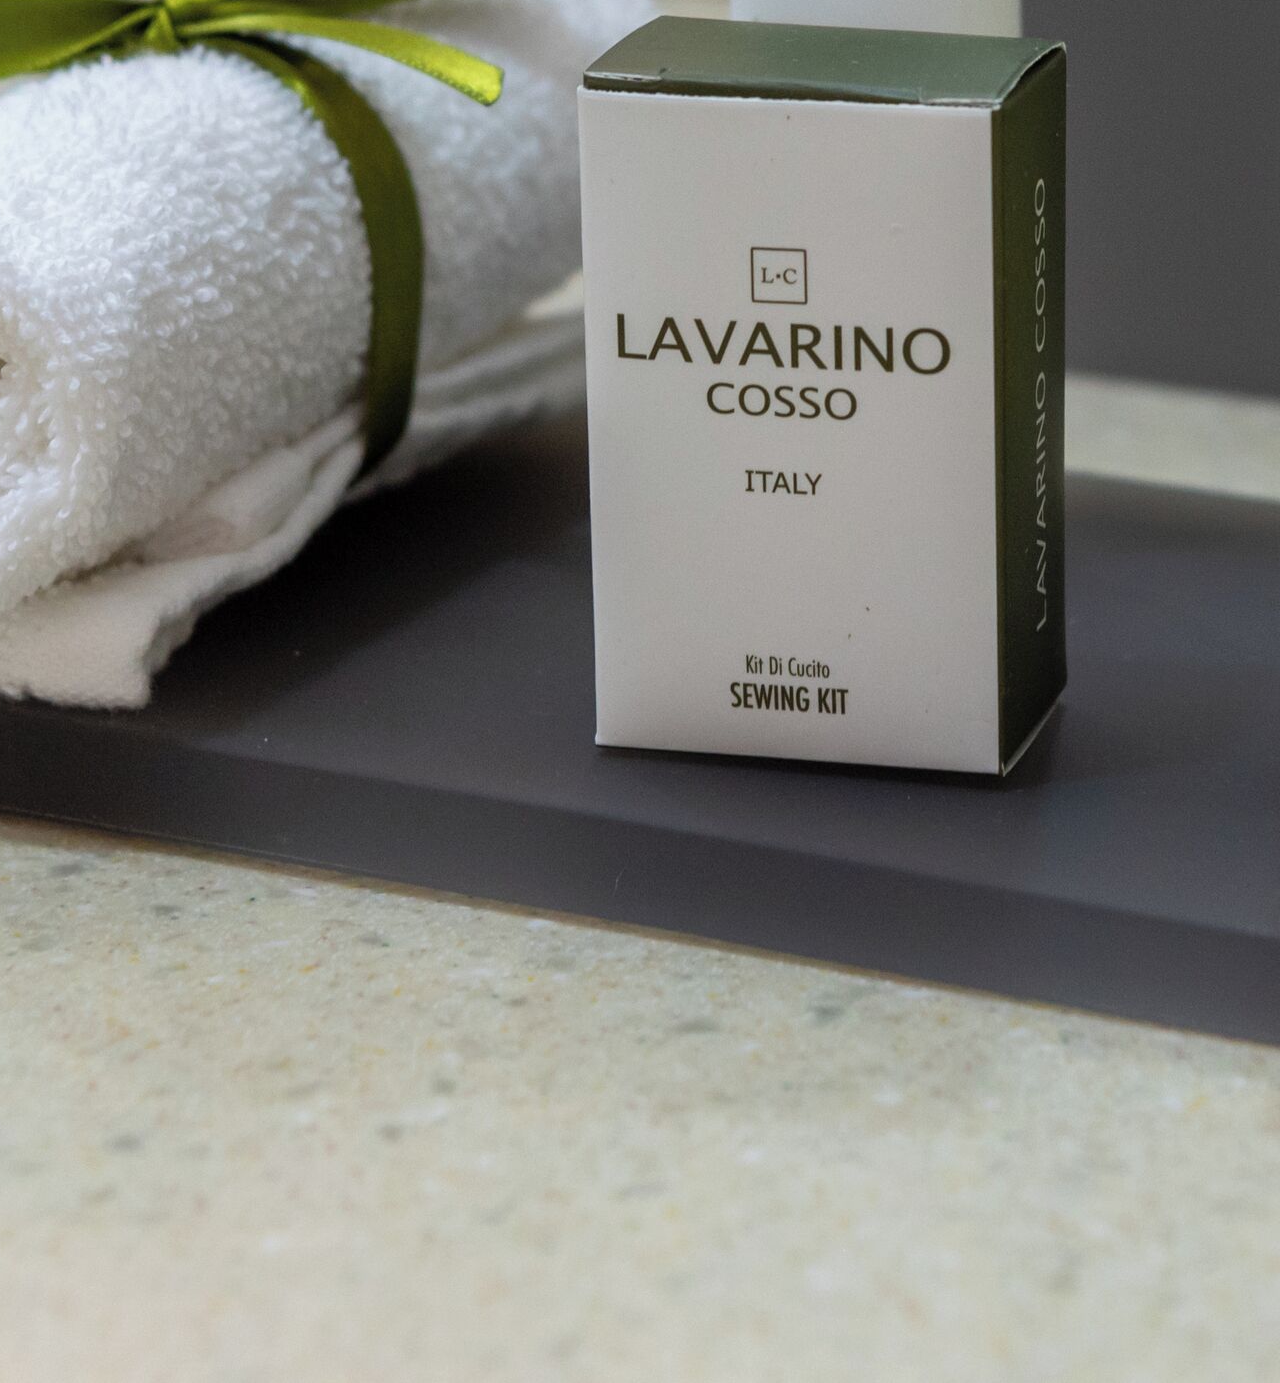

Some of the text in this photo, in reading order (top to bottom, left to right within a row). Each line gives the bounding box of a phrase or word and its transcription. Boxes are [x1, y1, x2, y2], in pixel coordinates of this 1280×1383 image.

[616, 312, 952, 376] LAVARINO
[706, 381, 858, 421] COSSO
[1033, 177, 1048, 631] LAVARINO COSSO
[744, 469, 823, 496] ITALY
[745, 654, 831, 679] Kit Di Cucito
[729, 681, 849, 715] SEWING KIT
